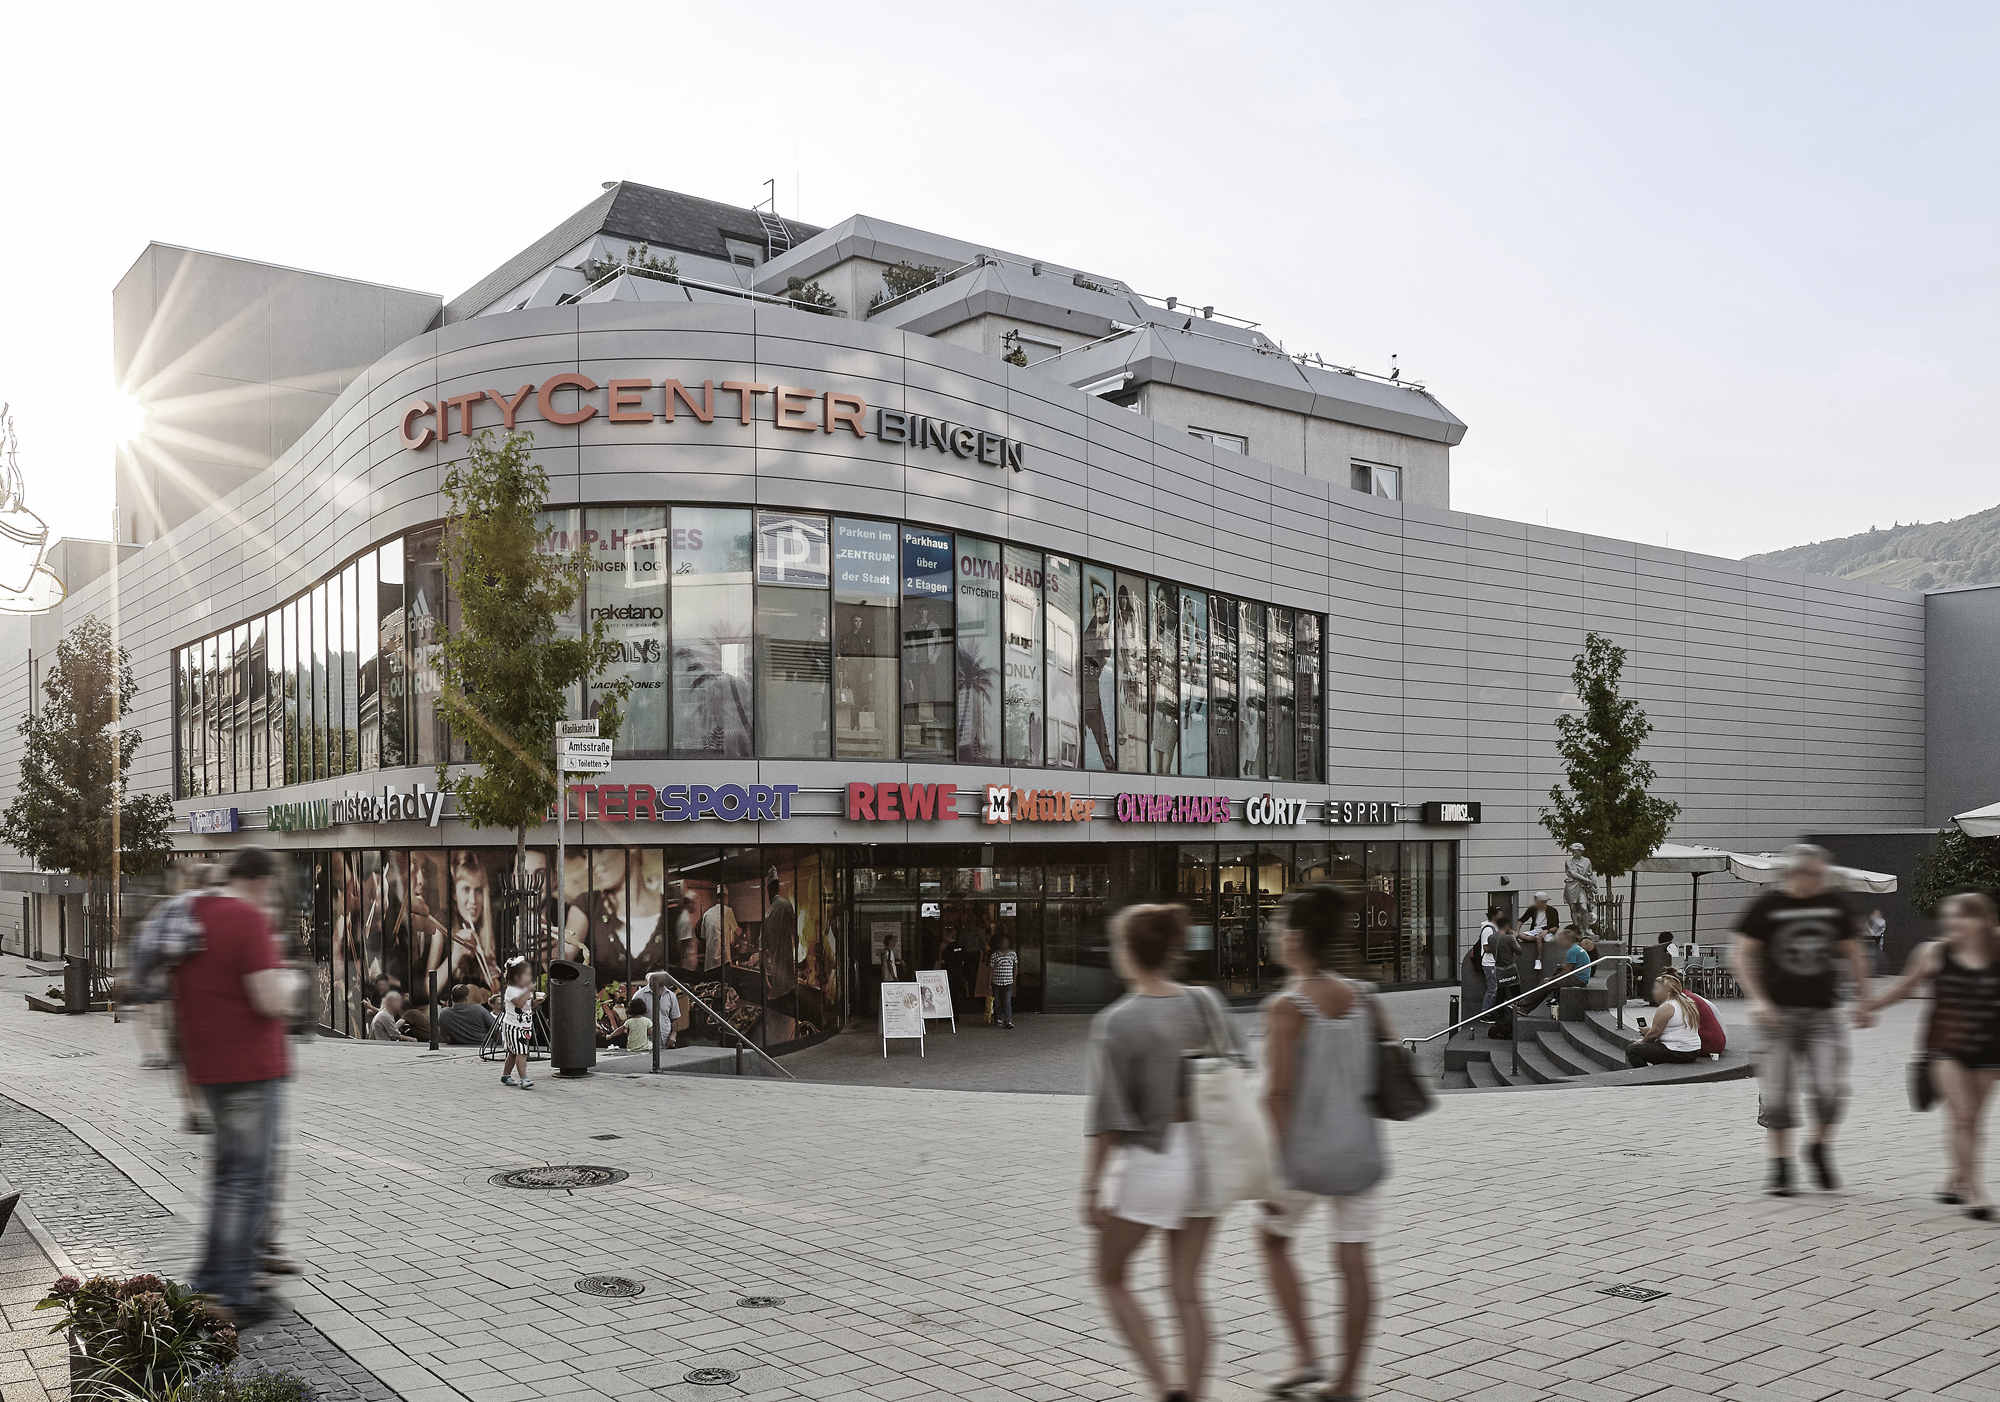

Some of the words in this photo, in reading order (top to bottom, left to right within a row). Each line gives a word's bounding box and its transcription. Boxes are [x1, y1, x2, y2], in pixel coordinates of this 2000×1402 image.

[877, 408, 1024, 472] BINGEN
[839, 527, 876, 541] Parken
[879, 531, 892, 541] im
[905, 534, 949, 550] Parkhaus
[917, 557, 938, 569] über
[842, 571, 858, 582] der
[863, 573, 890, 585] Stadt
[907, 578, 913, 588] 2
[915, 579, 948, 593] Etagen
[591, 604, 664, 620] naketano
[569, 742, 610, 752] Amtsstraße
[849, 782, 958, 821] REWE
[1016, 789, 1096, 822] Müller
[1330, 801, 1398, 823] ESPRIT
